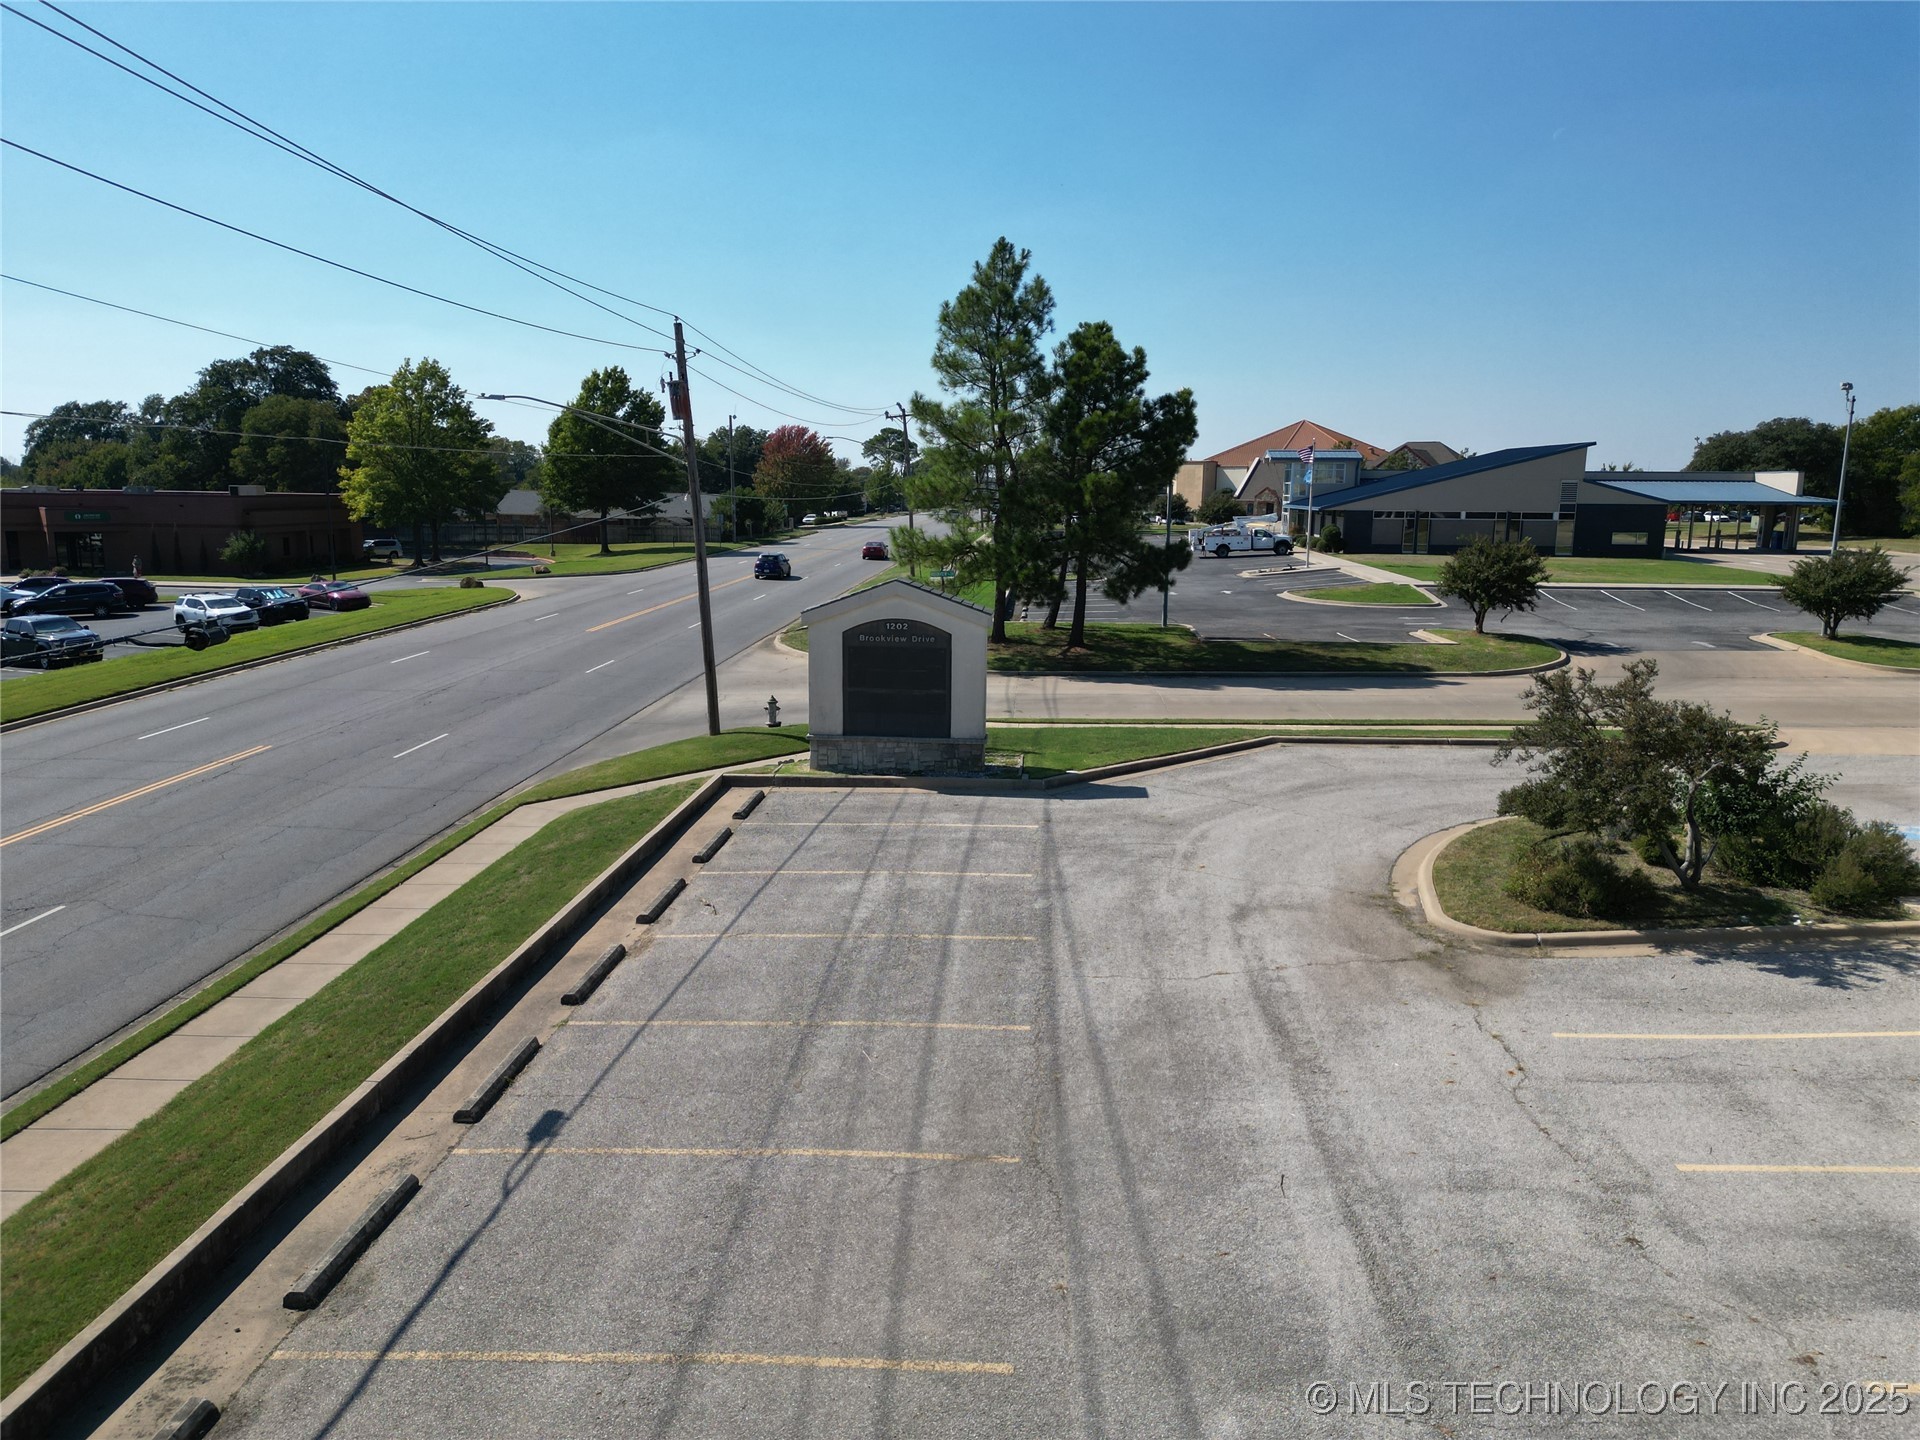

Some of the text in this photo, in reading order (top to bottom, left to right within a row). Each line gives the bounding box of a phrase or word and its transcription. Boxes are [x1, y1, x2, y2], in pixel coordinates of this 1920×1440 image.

[886, 622, 908, 630] 1202
[859, 634, 936, 643] Brookview Drive
